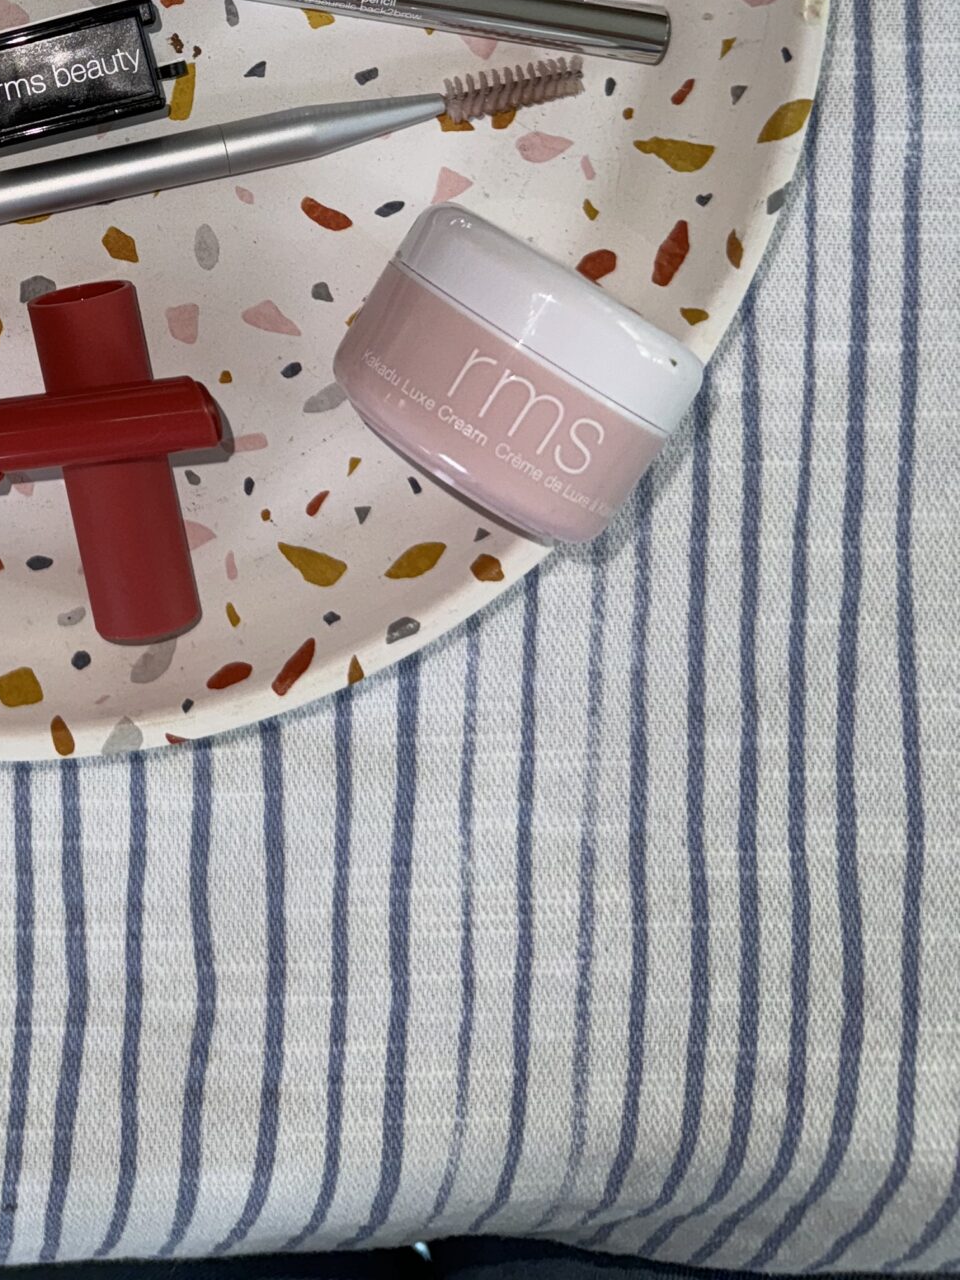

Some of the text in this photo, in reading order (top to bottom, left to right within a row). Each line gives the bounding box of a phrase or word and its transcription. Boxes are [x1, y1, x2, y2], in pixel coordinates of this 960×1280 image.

[52, 47, 142, 89] beauty
[361, 348, 401, 387] Kakadu
[400, 378, 436, 412] Luxe
[437, 404, 489, 447] Cream
[543, 475, 563, 493] de
[447, 347, 605, 475] rms
